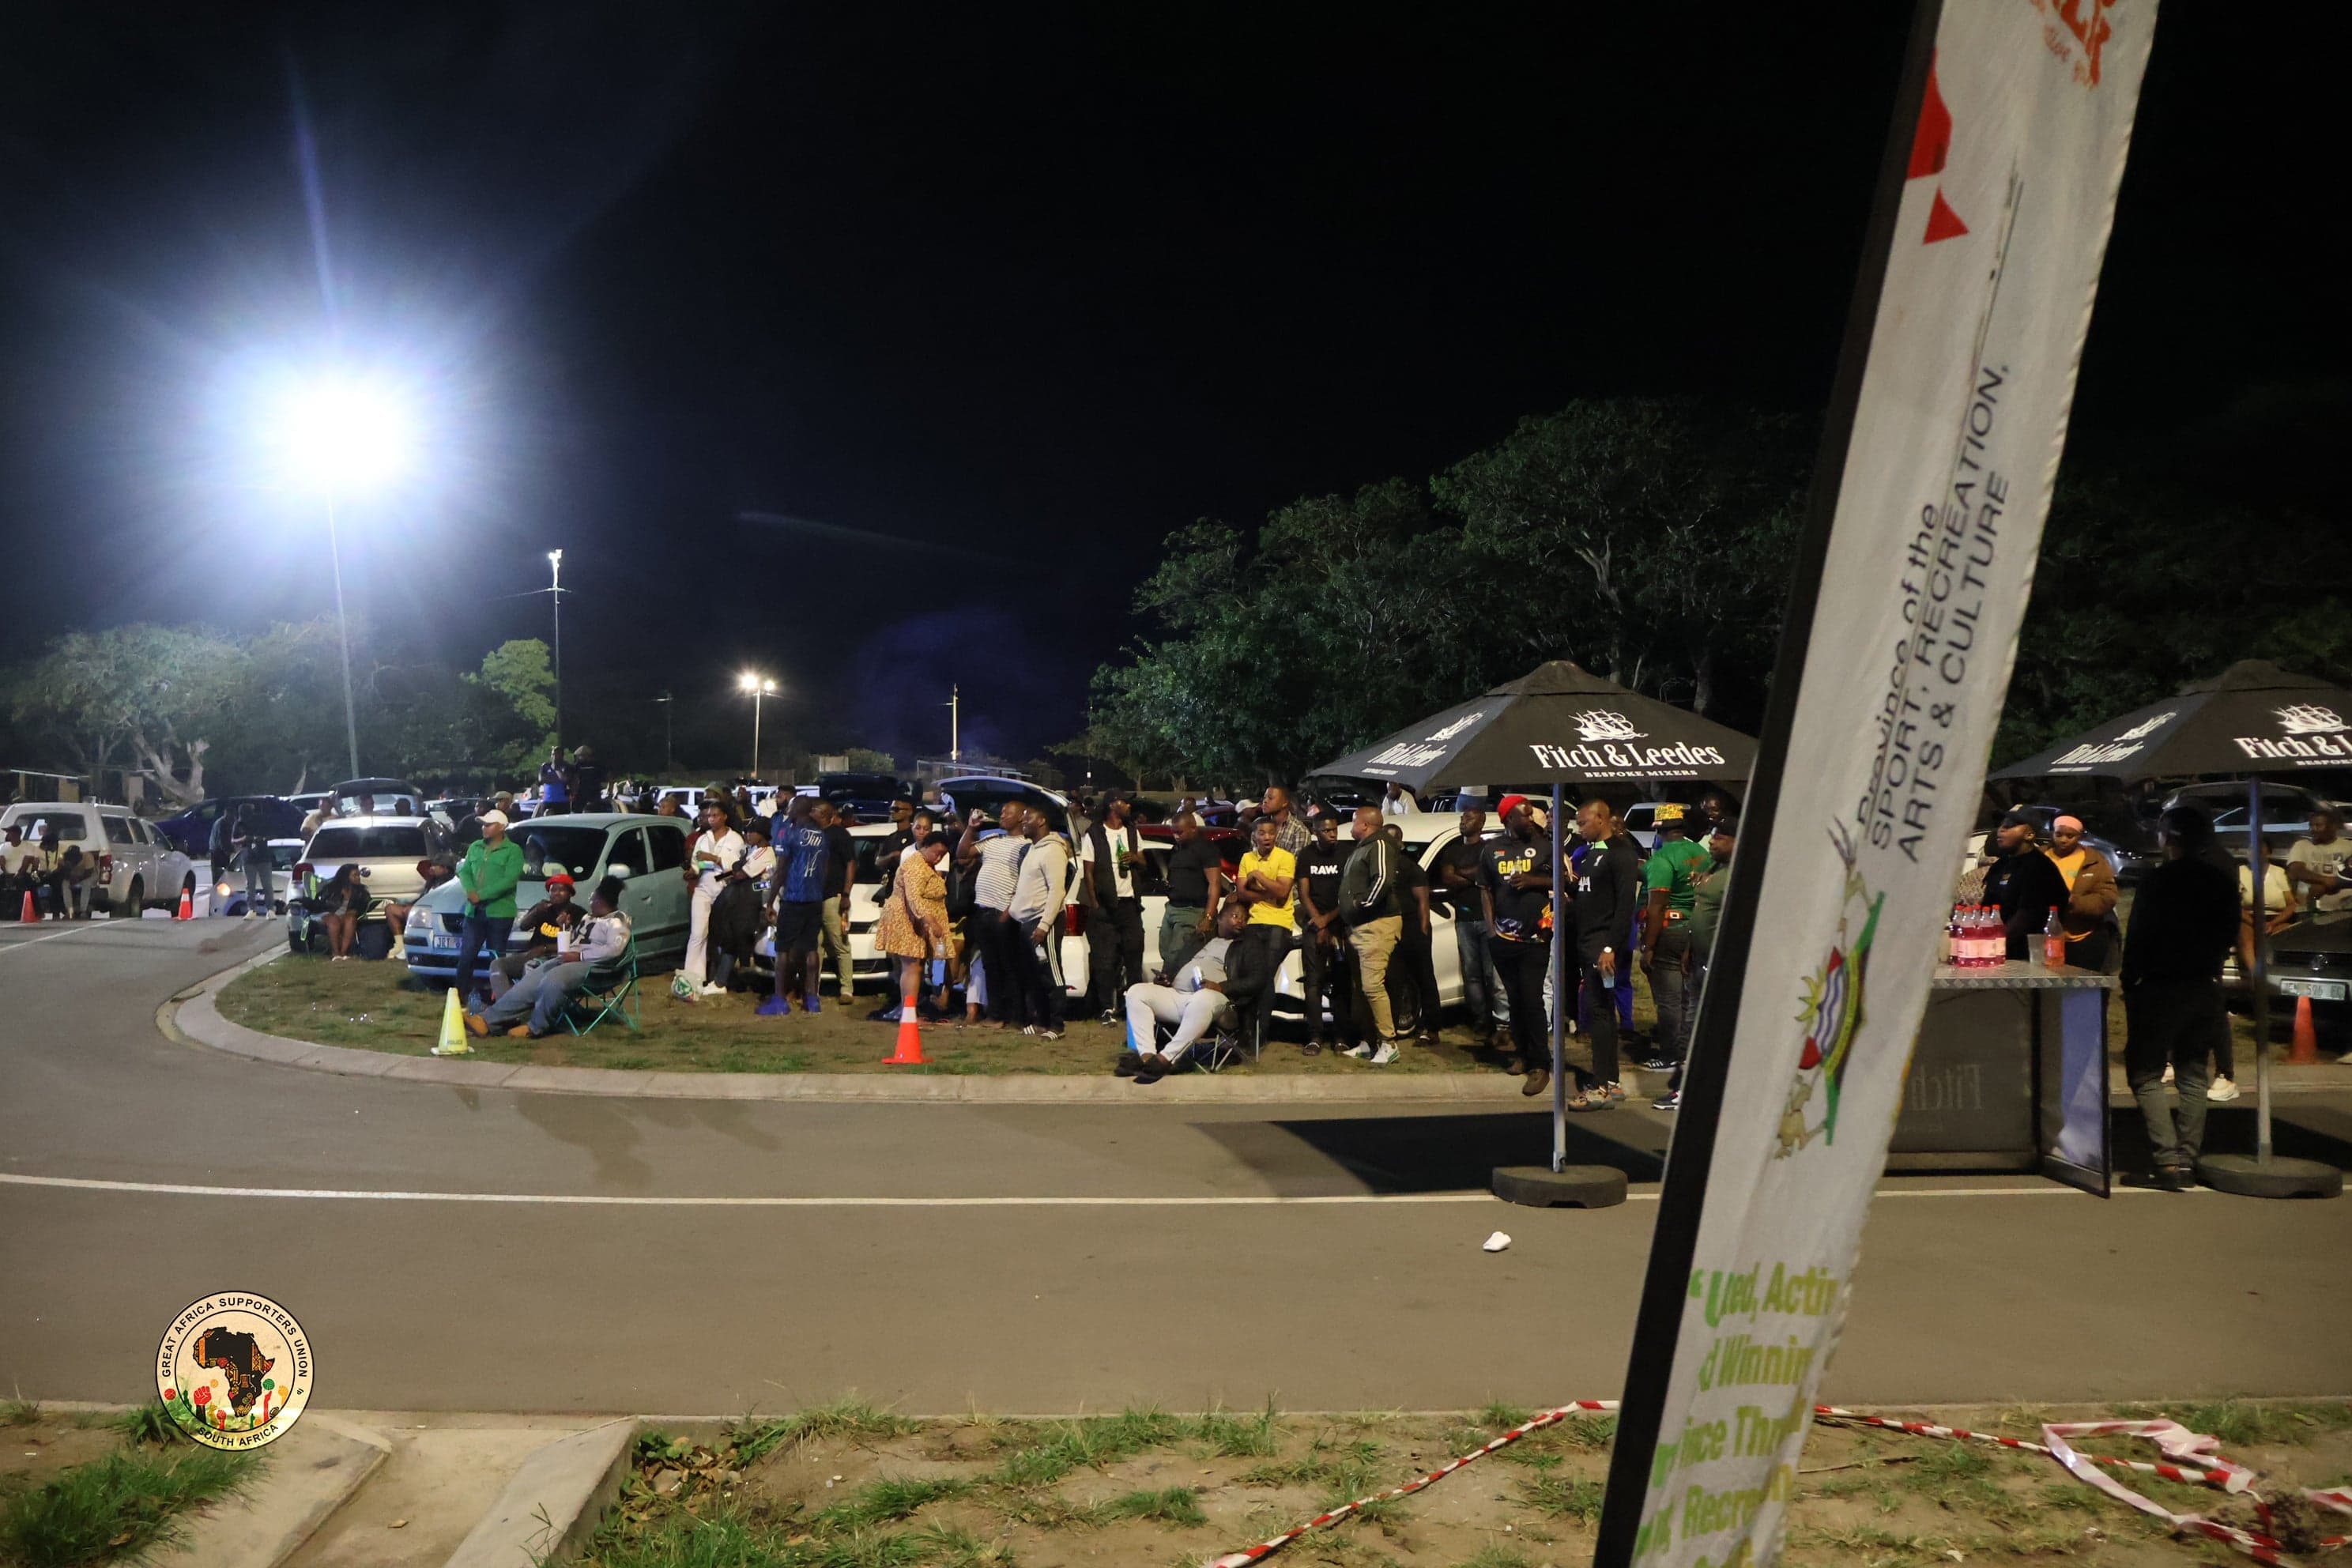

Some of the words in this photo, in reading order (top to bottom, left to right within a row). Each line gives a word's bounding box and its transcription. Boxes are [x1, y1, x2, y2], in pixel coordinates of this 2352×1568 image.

[1907, 503, 1936, 570] the
[1901, 577, 1921, 624] of
[1940, 471, 2010, 684] CULTURE
[1871, 684, 1930, 850] SPORT,
[1914, 364, 2009, 667] RECREATION,
[1930, 702, 1955, 729] &
[1529, 744, 1608, 768] Fitch
[1604, 744, 1632, 766] &
[1624, 741, 1725, 767] Leedes
[2233, 736, 2319, 759] Fitch
[2312, 735, 2346, 756] &
[1898, 740, 1943, 863] ARTS
[1310, 865, 1339, 875] RAW.
